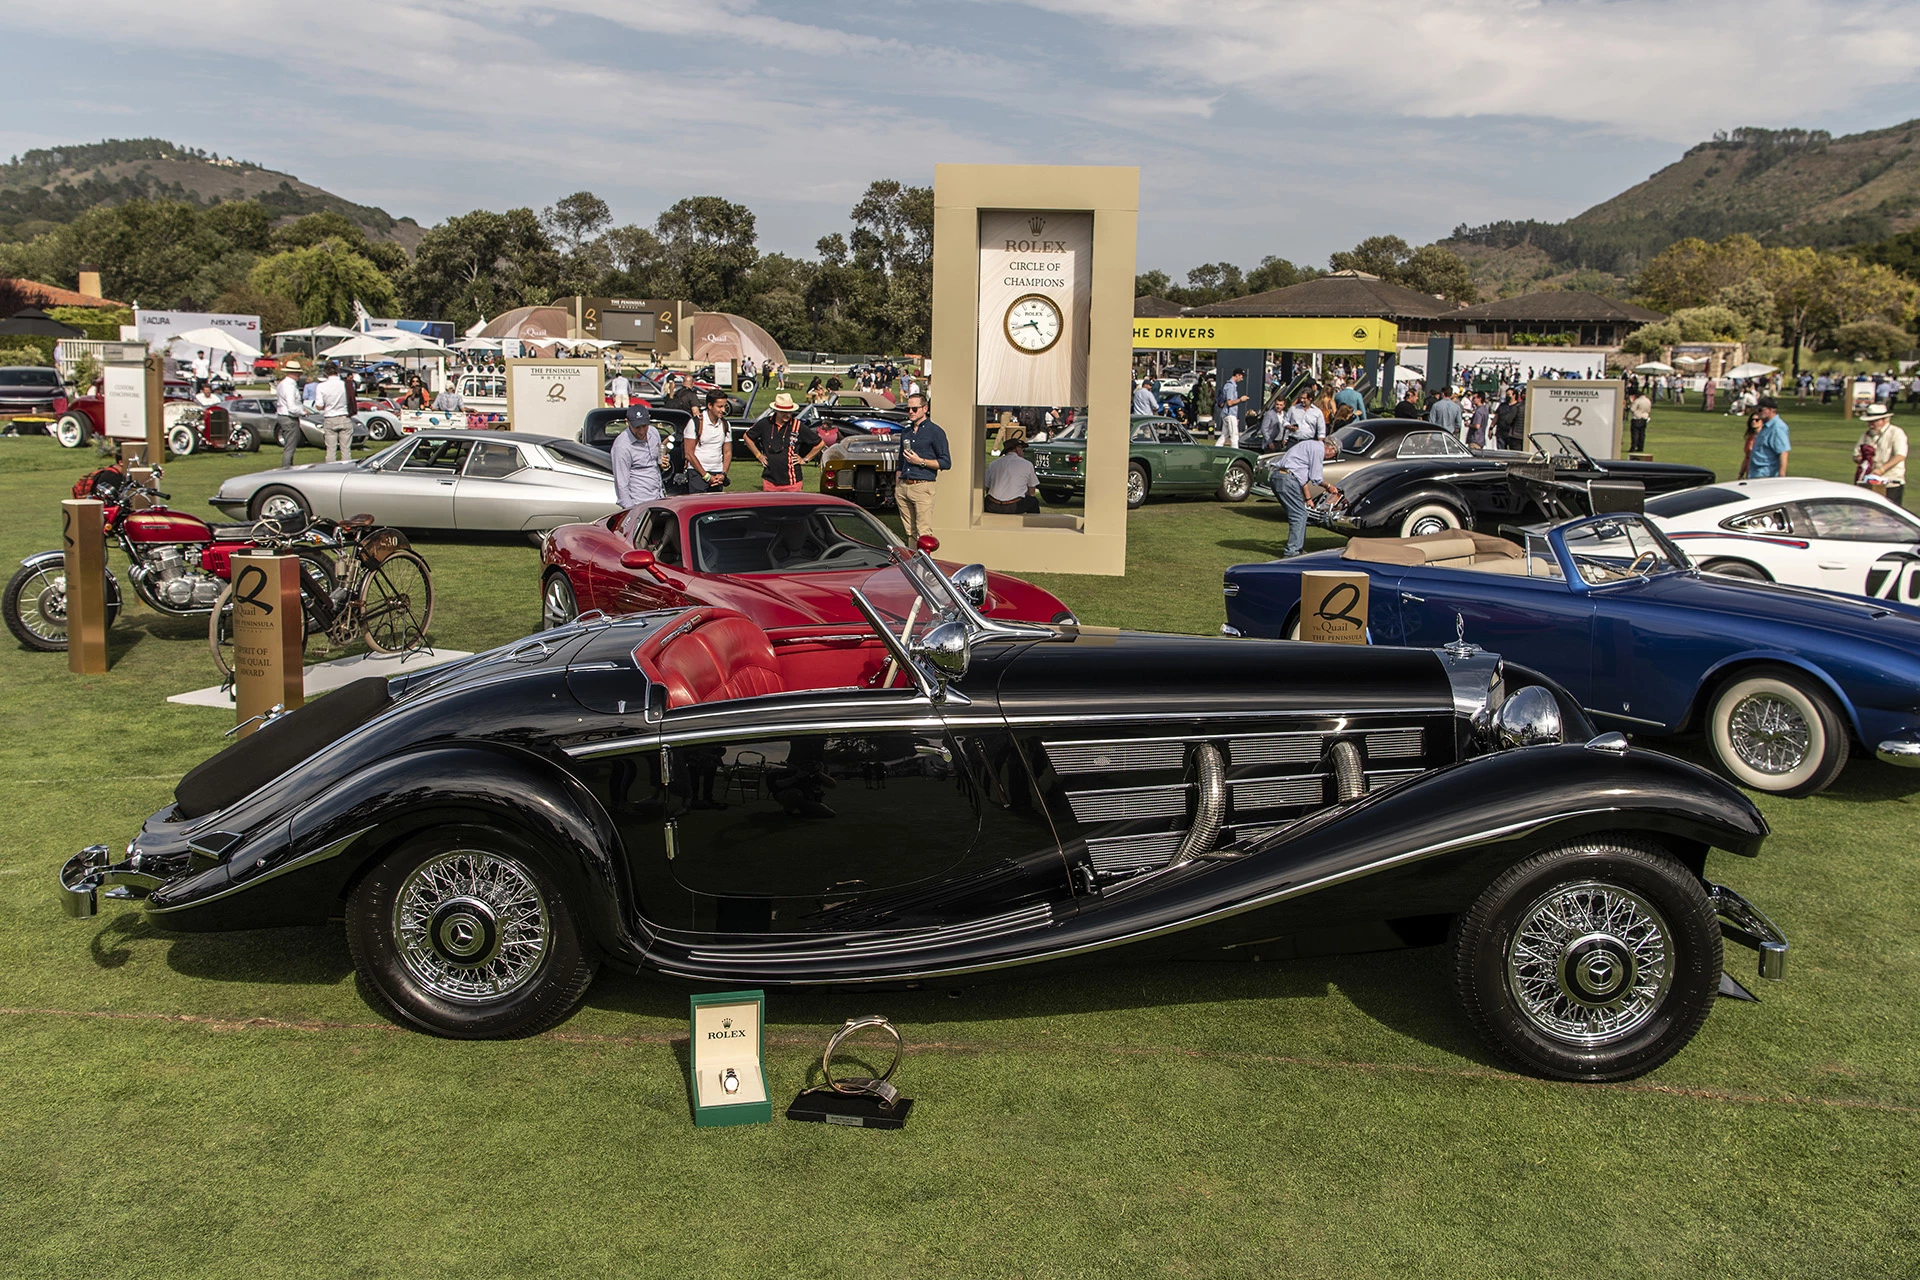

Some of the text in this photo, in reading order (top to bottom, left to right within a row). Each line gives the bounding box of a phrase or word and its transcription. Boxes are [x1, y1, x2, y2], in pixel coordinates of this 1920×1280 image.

[1004, 240, 1067, 254] ROLEX
[1009, 261, 1061, 271] CIRCLE OF
[1003, 277, 1065, 287] CHAMPIONS
[146, 316, 171, 325] ACURA
[247, 321, 257, 330] S
[526, 327, 547, 337] Quail
[1155, 328, 1215, 338] DRIVERS
[707, 333, 727, 343] Quail
[1872, 560, 1920, 607] 70
[236, 605, 256, 618] Quail
[241, 620, 274, 628] PENINSULA
[1321, 621, 1348, 633] Quail
[256, 647, 268, 656] OF
[247, 657, 272, 667] QUAIL
[707, 1030, 746, 1040] ROLEX
